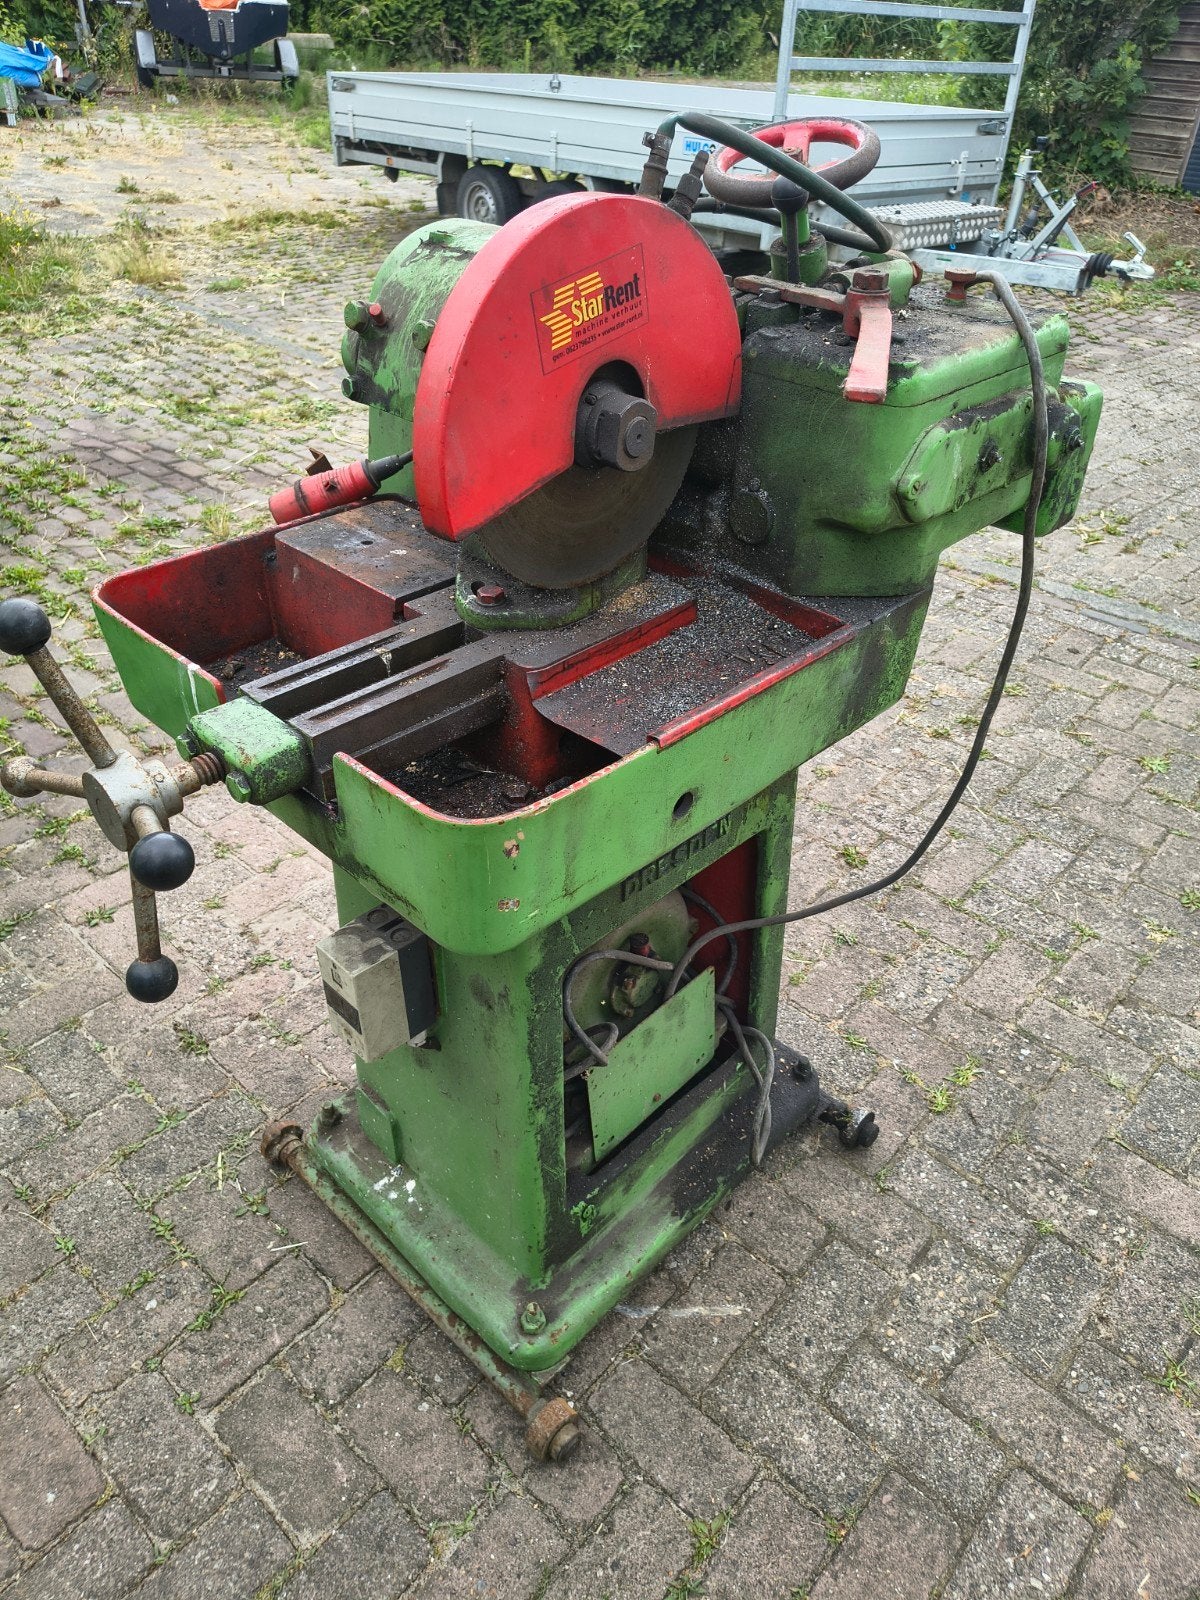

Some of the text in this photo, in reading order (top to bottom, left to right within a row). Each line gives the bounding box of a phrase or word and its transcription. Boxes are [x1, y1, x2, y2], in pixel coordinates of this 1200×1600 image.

[571, 273, 641, 327] StarRent
[575, 300, 642, 338] machine verhuur
